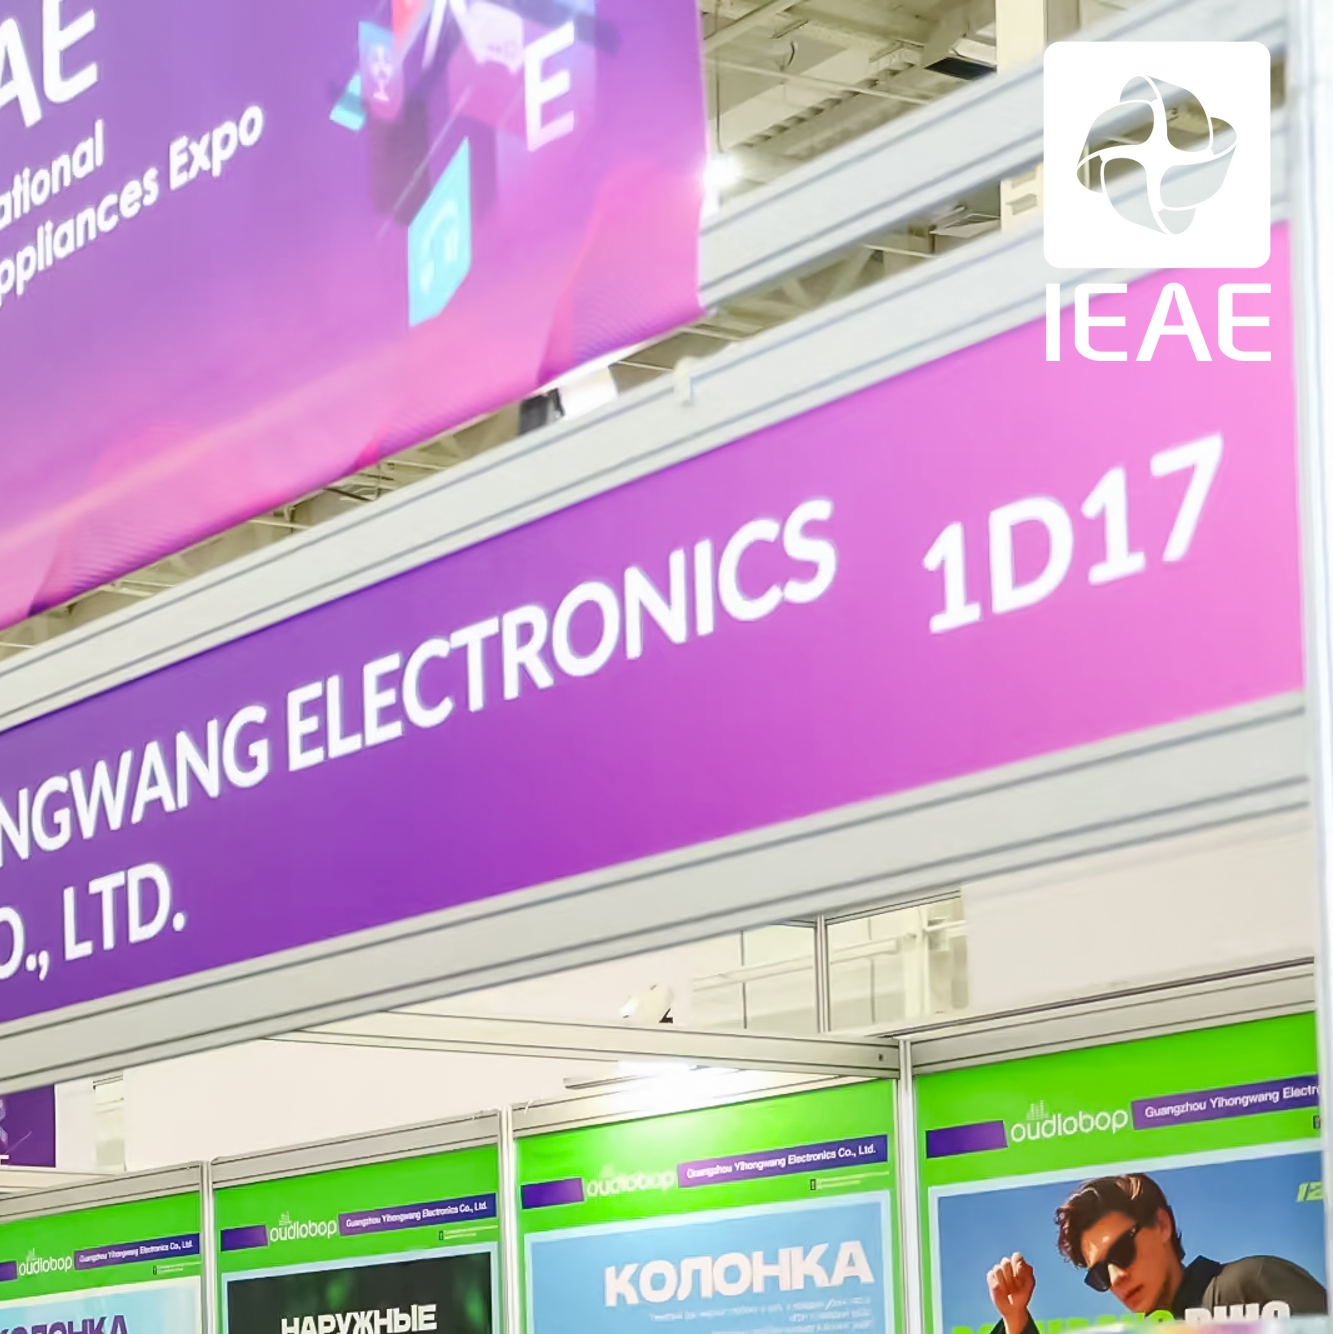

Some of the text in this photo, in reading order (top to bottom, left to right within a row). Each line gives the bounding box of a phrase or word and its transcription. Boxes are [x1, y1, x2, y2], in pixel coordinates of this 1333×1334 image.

[169, 105, 265, 192] Expo
[922, 431, 1223, 634] 1D17
[286, 499, 839, 773] ELECTRONICS
[62, 863, 187, 962] LTD.
[1144, 1084, 1320, 1119] Guangzhou Yihongwang Electr
[686, 1143, 876, 1179] Guangzhou Yihongwang Electronics Co., Ltd.
[422, 1205, 459, 1219] Electronics
[604, 1240, 874, 1307] КОЛОНКА
